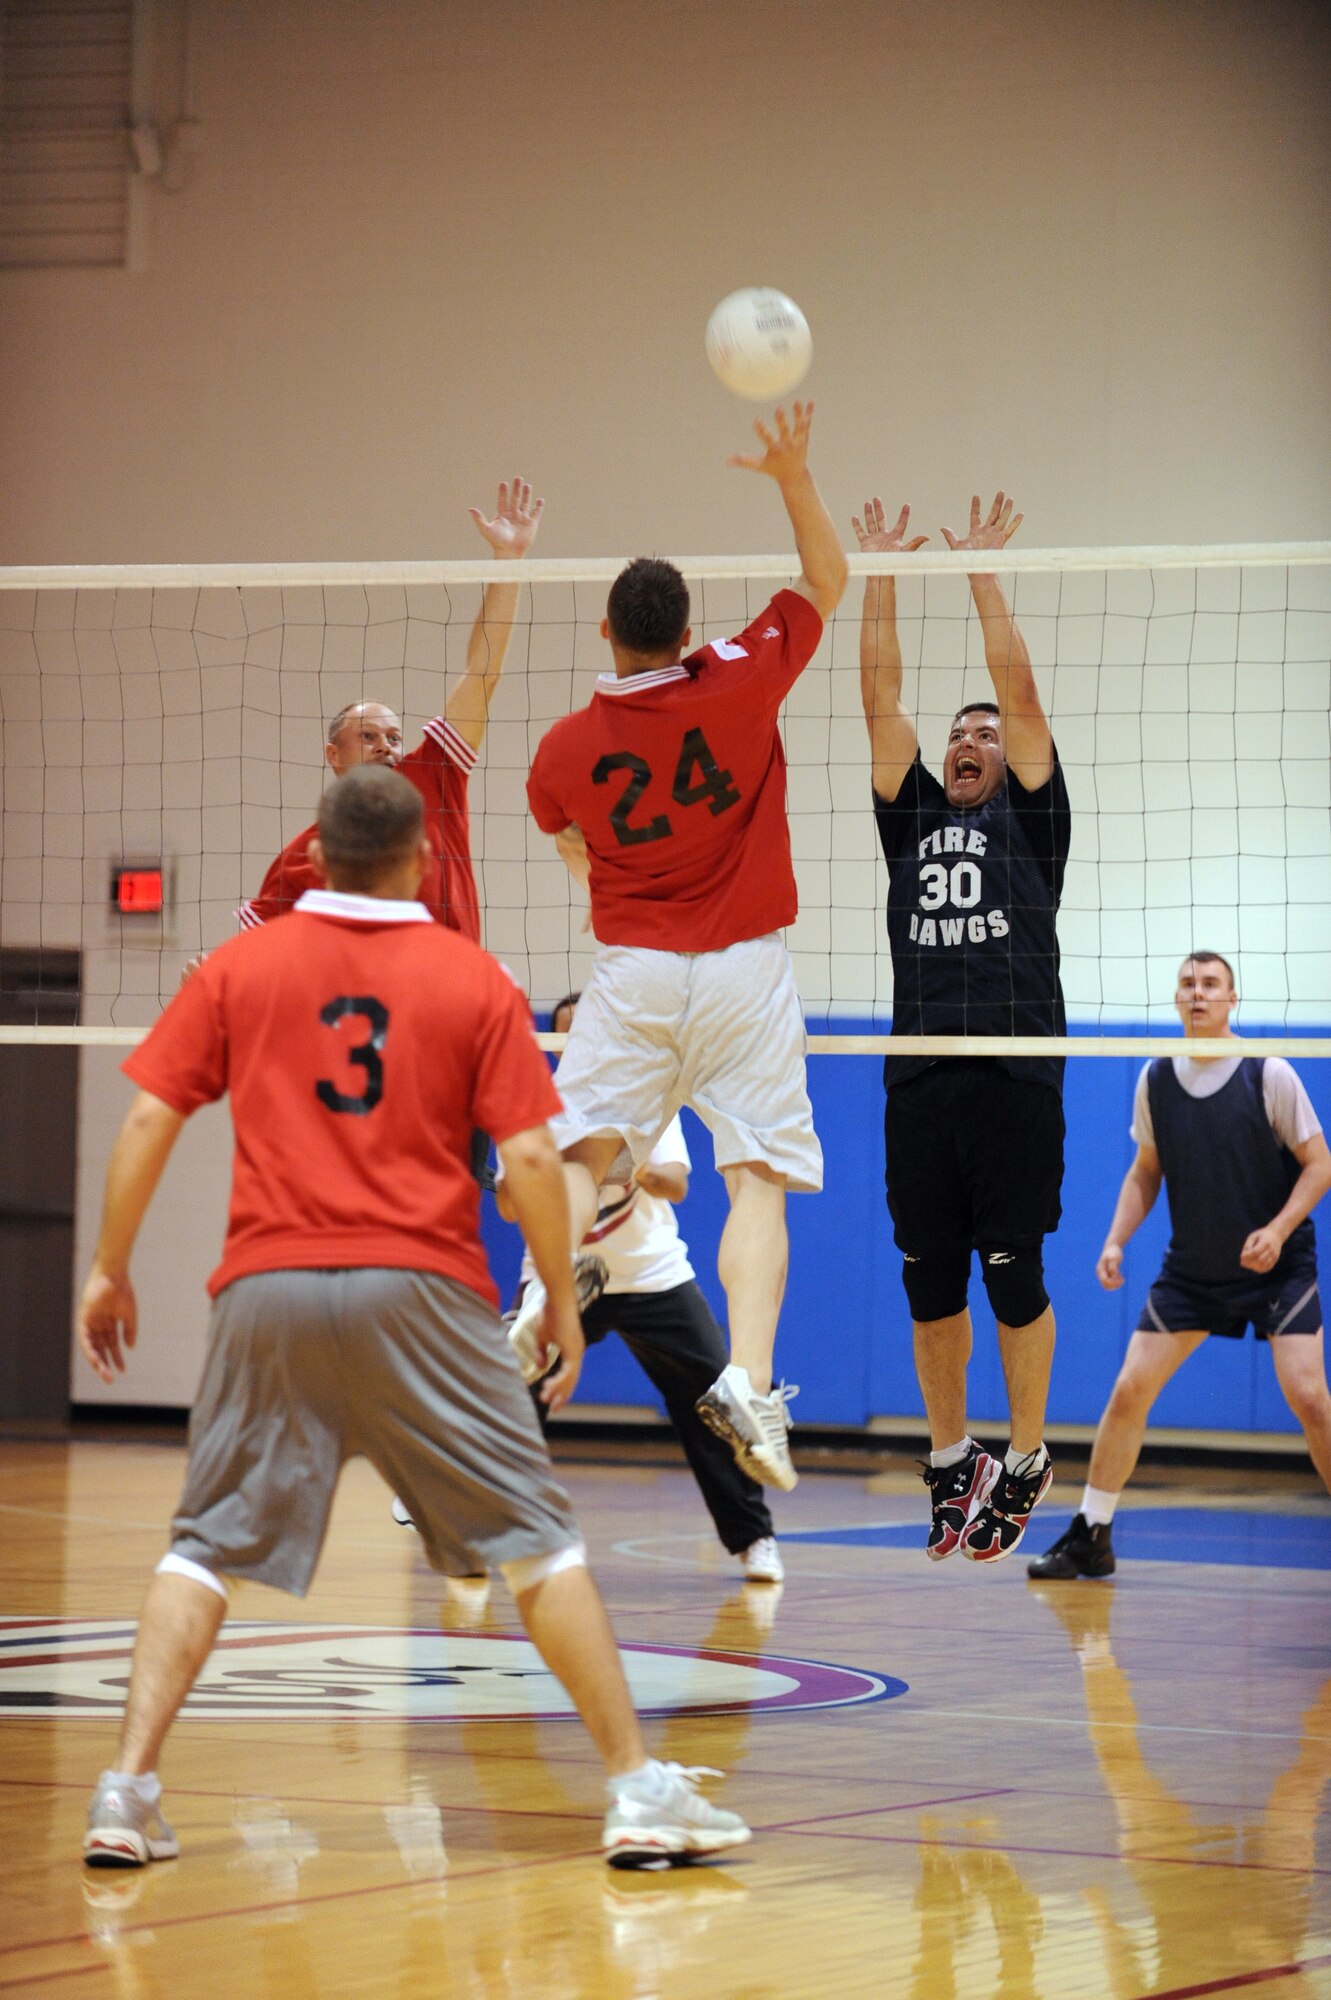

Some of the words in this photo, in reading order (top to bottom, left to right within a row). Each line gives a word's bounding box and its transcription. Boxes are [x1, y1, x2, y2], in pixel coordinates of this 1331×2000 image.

[592, 727, 741, 846] 24
[919, 826, 987, 861] FIRE
[919, 862, 981, 911] 30
[909, 909, 1009, 946] DAWGS
[316, 996, 389, 1116] 3
